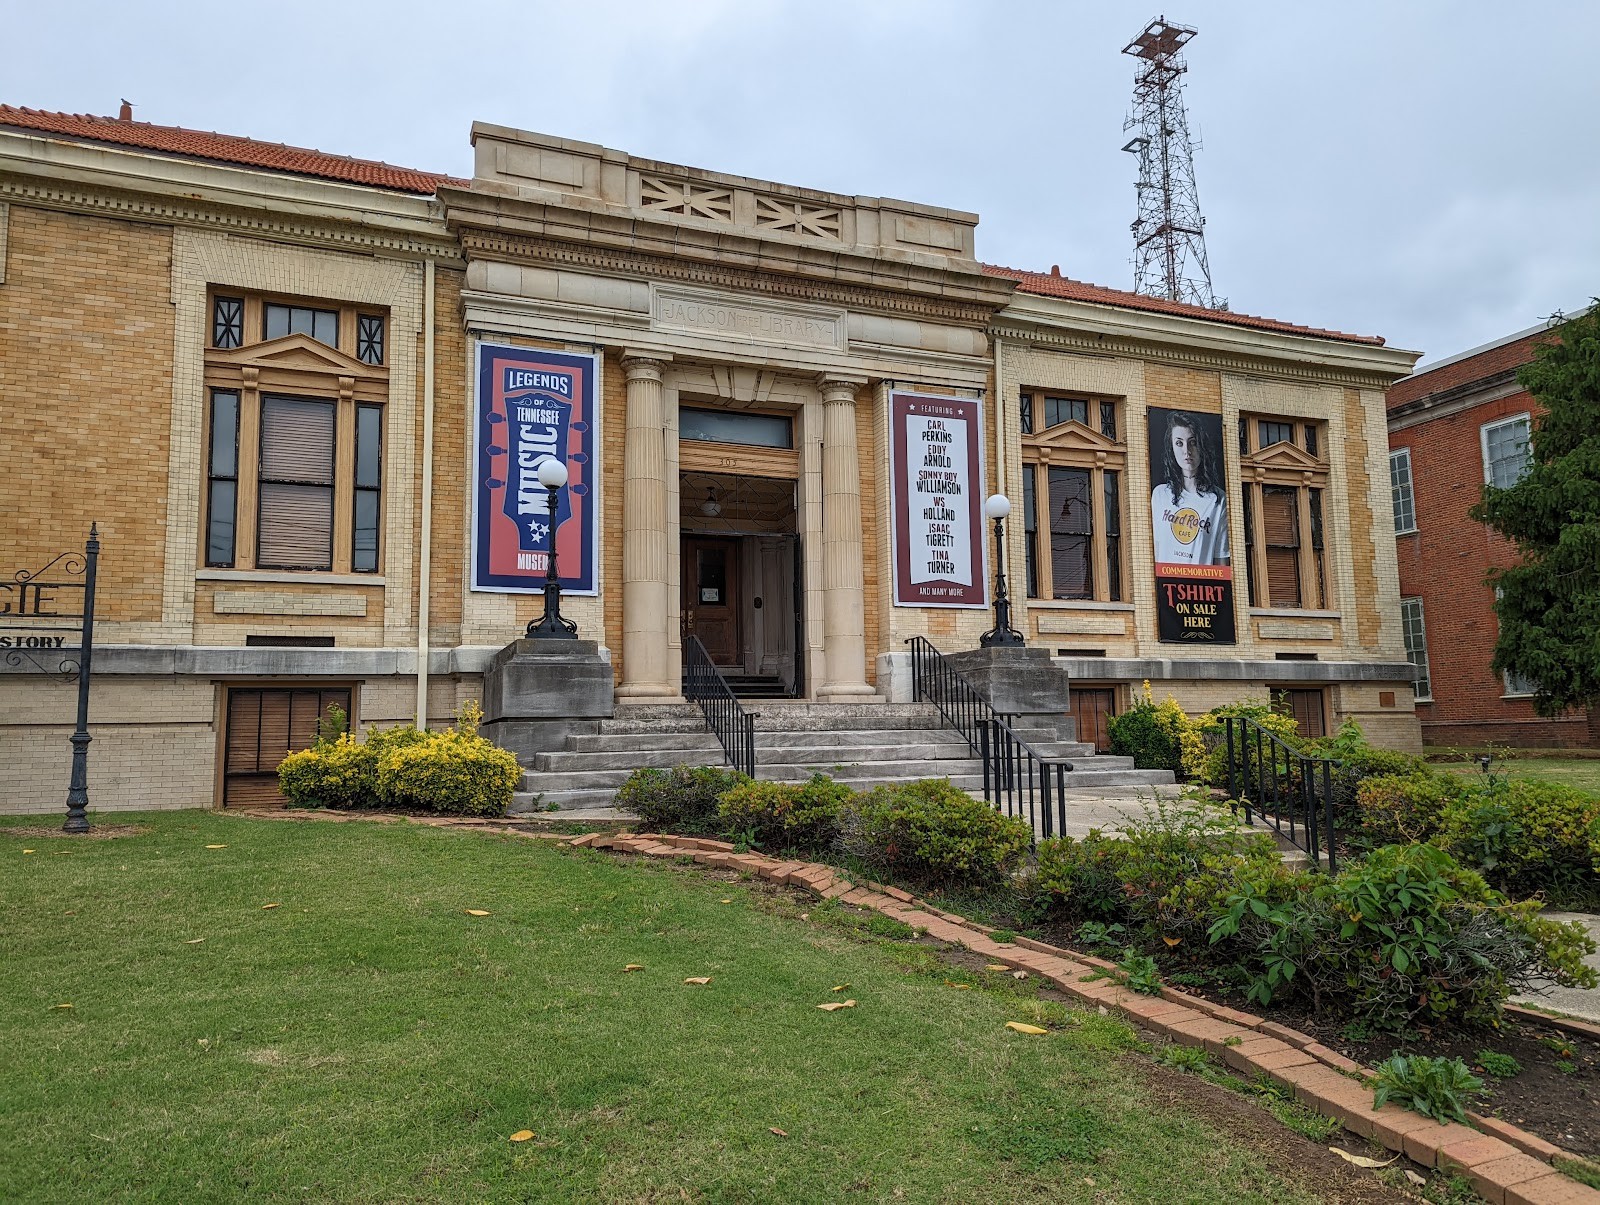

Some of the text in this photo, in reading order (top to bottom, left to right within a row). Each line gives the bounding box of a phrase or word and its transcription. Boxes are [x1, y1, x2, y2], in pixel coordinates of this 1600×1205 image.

[665, 303, 827, 340] JACKSON FREE LIBRARY
[509, 371, 569, 394] LEGENDS
[517, 406, 560, 425] TENNESSEE
[921, 404, 954, 415] FEATURING
[927, 419, 946, 432] CARL
[922, 431, 953, 444] PERKINS
[927, 444, 947, 456] EDDY
[720, 458, 737, 467] 305
[923, 454, 952, 469] ARNOLD
[918, 469, 958, 483] SONNY BOY
[916, 479, 962, 496] WILLIAMSON
[933, 496, 946, 508] WS
[923, 507, 956, 522] HOLLAND
[1162, 508, 1212, 535] Hard Rock
[928, 522, 951, 535] ISAAC
[925, 533, 955, 548] TIGRETT
[517, 552, 550, 571] MUSEU
[931, 549, 949, 562] TINA
[927, 560, 956, 575] TURNER
[1161, 566, 1224, 578] COMMEMORATIVE
[919, 586, 964, 598] AND MANY MORE
[1175, 602, 1218, 616] ON SALE
[1183, 616, 1212, 628] HERE
